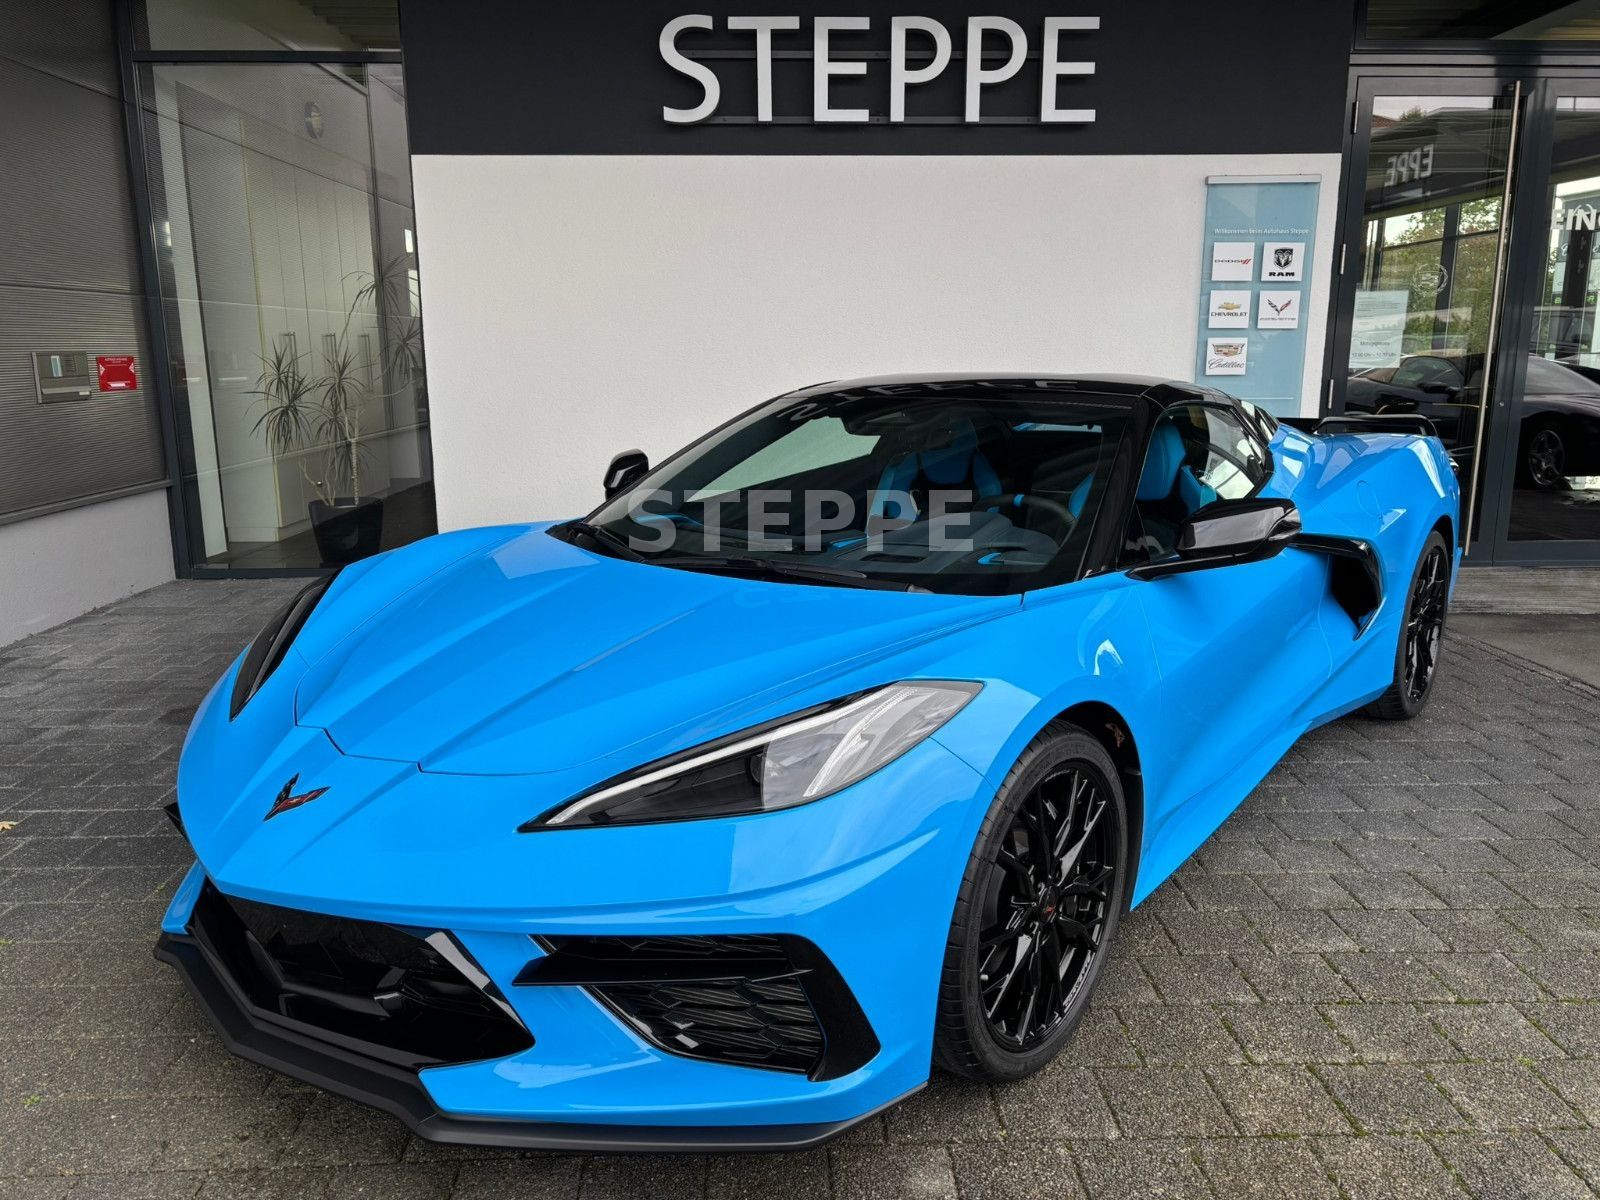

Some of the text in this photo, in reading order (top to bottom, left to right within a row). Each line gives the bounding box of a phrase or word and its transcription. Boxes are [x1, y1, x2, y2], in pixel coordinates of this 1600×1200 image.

[659, 14, 1100, 124] STEPPE
[1551, 208, 1600, 231] EIN
[1263, 227, 1290, 235] Autohaus
[1290, 227, 1309, 236] Steppe
[1207, 358, 1245, 370] Cadillac
